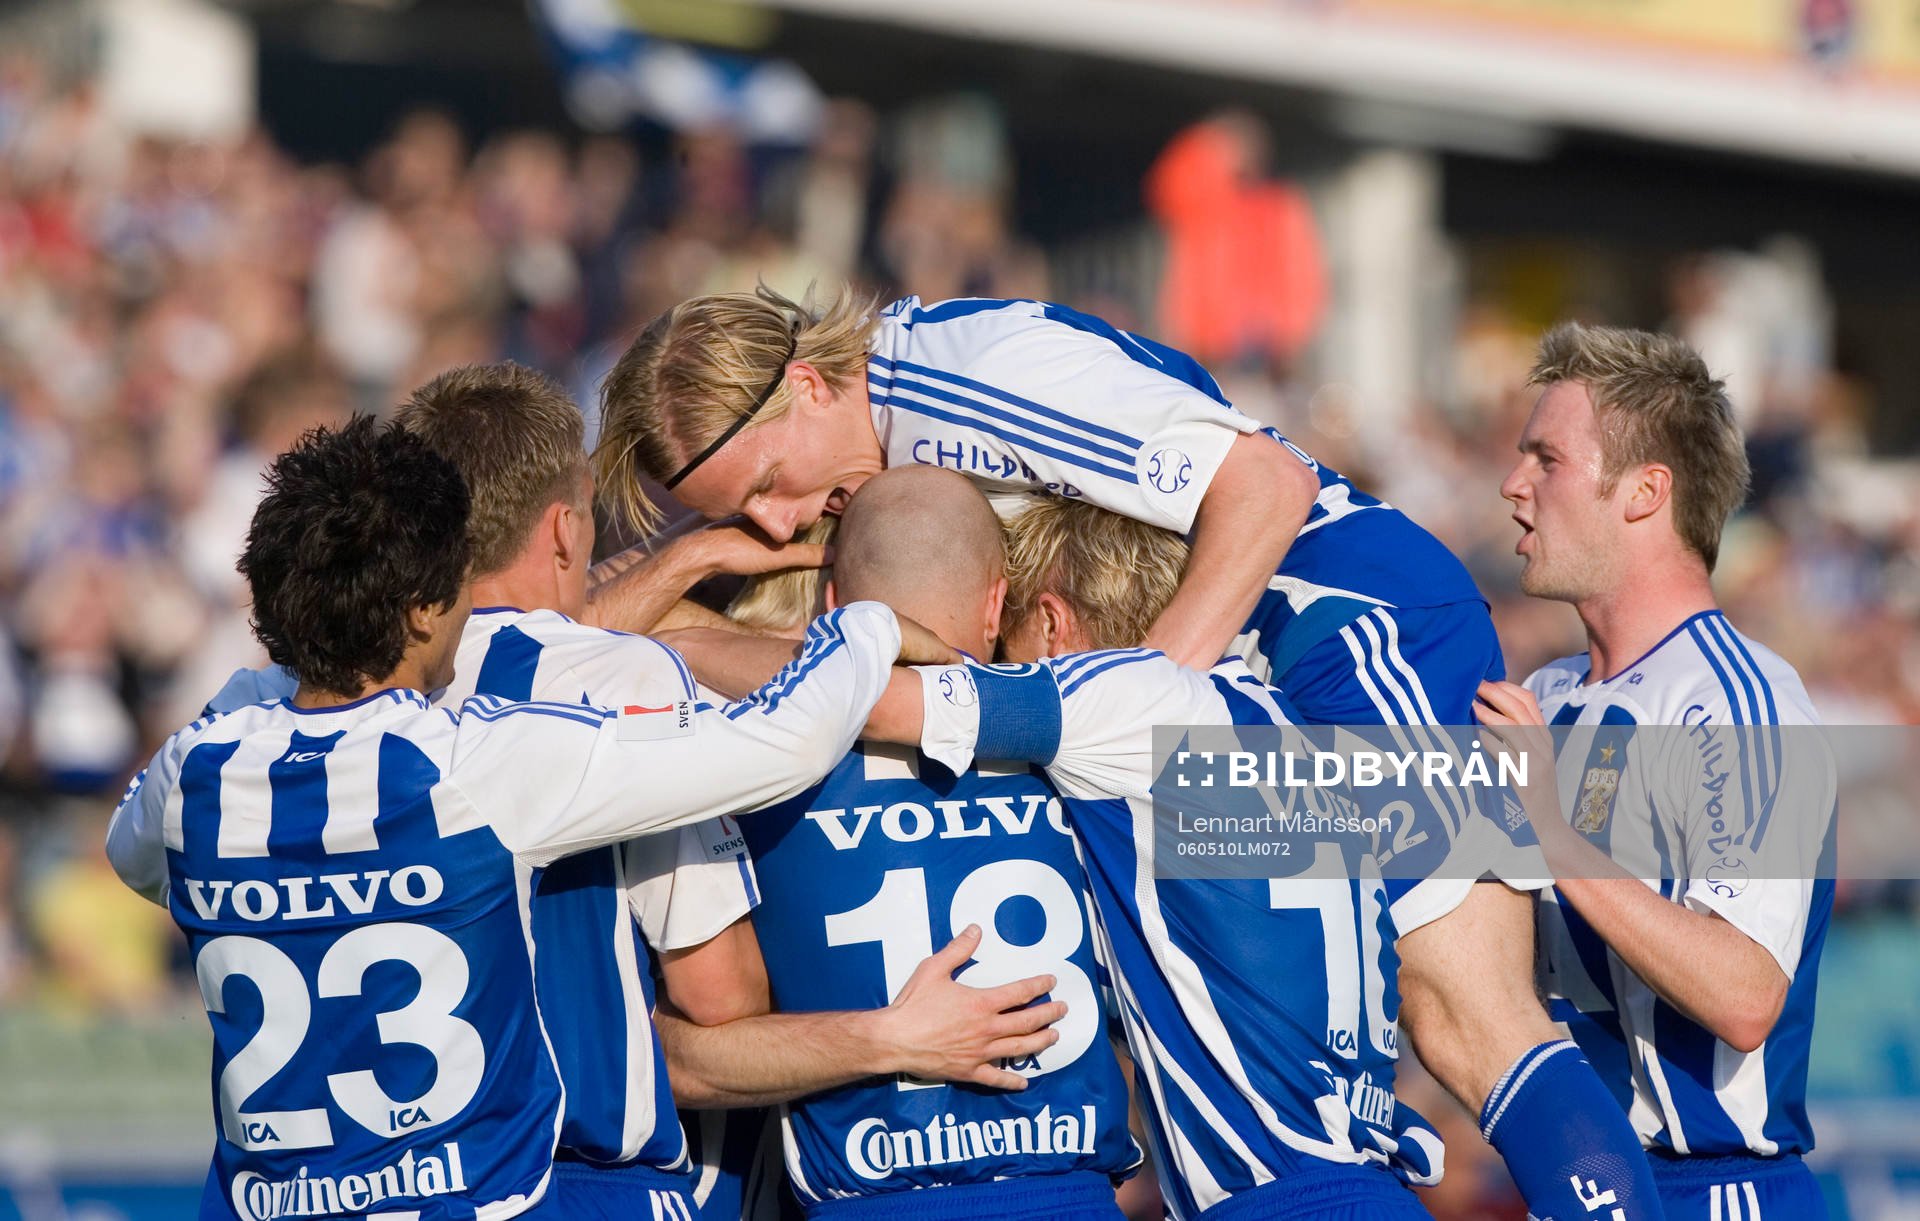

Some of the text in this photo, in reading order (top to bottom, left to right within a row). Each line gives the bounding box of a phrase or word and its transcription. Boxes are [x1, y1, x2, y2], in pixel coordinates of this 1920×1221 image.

[184, 865, 444, 922] VOLVO
[825, 859, 1100, 1092] 18
[196, 922, 486, 1152] 23
[1328, 1029, 1356, 1051] ICA
[1383, 1029, 1398, 1050] IC
[241, 1122, 281, 1144] ICA
[390, 1106, 432, 1132] ICA
[846, 1105, 1096, 1180] Continental
[231, 1142, 468, 1221] Continental
